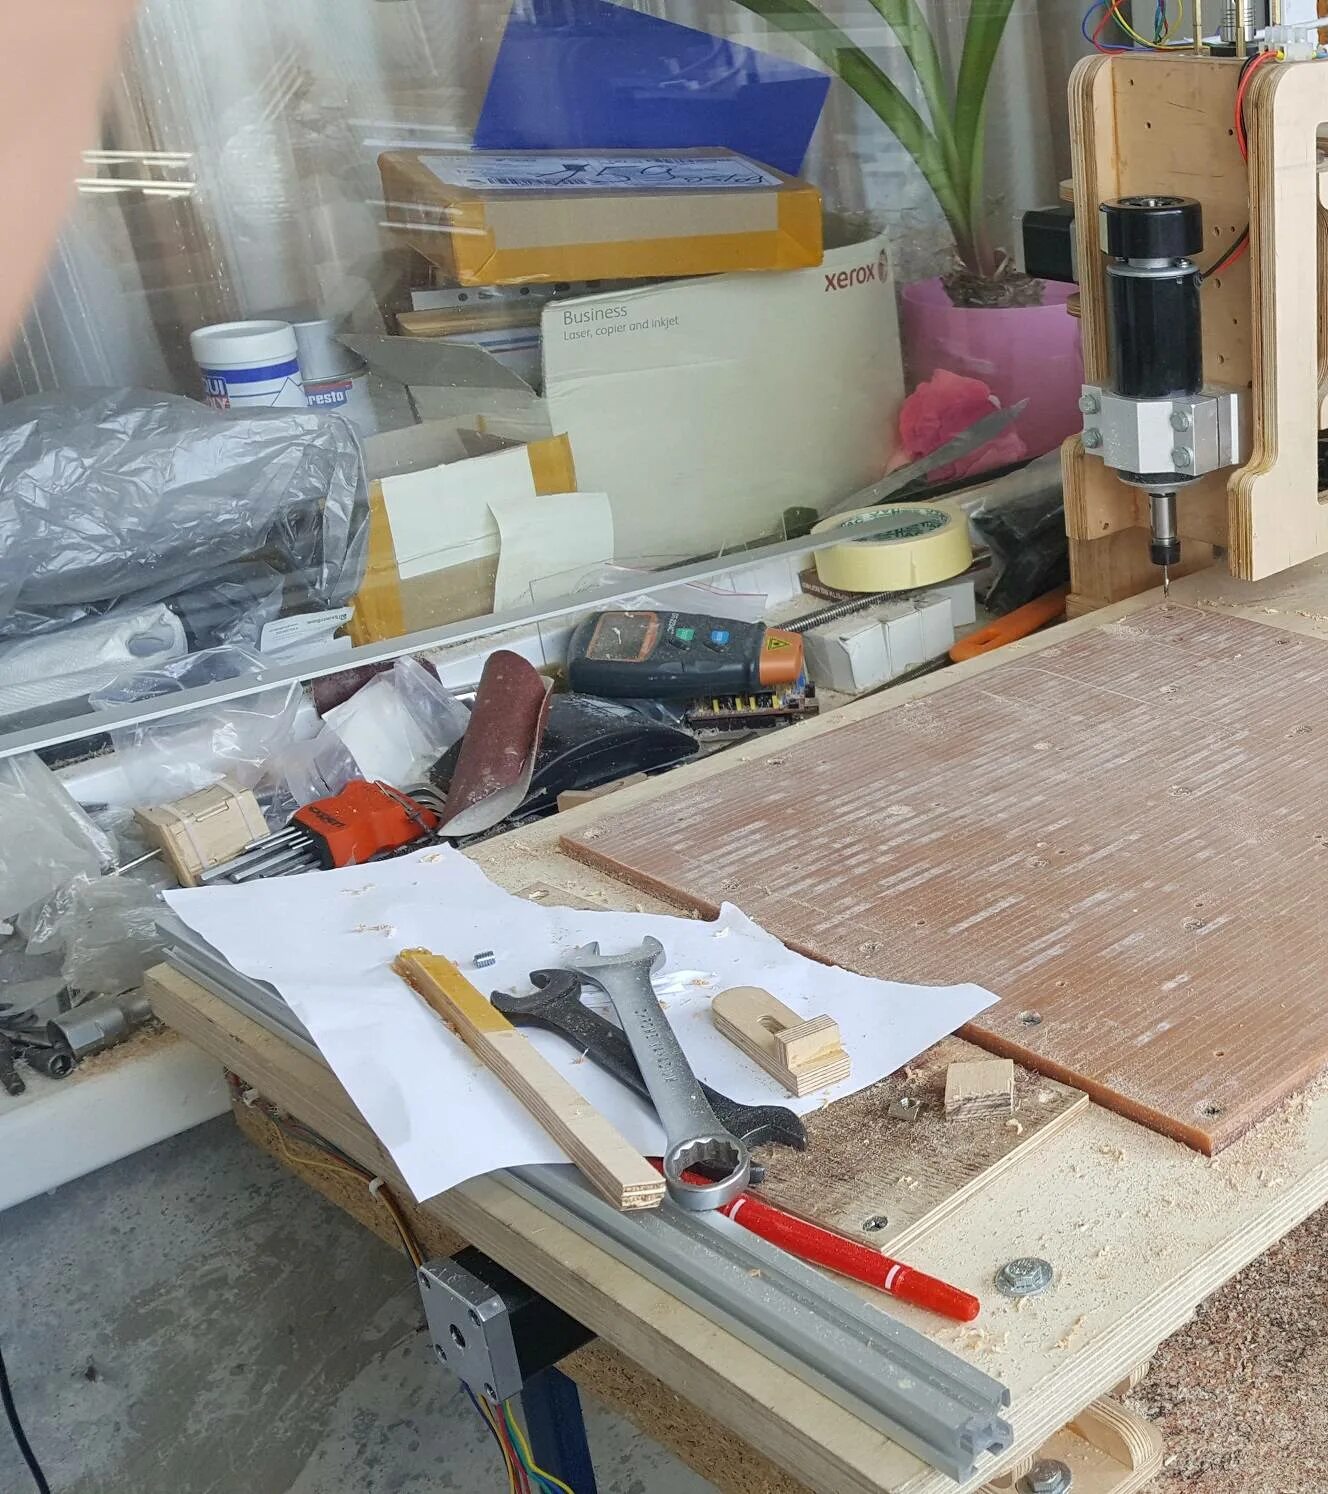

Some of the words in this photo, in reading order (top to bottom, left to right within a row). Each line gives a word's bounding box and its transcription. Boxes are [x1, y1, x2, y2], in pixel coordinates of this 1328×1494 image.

[825, 263, 875, 292] xerox
[563, 306, 628, 325] Business
[563, 330, 593, 340] Laser,
[595, 324, 626, 336] copier
[629, 319, 649, 331] and
[651, 315, 679, 328] inkjet
